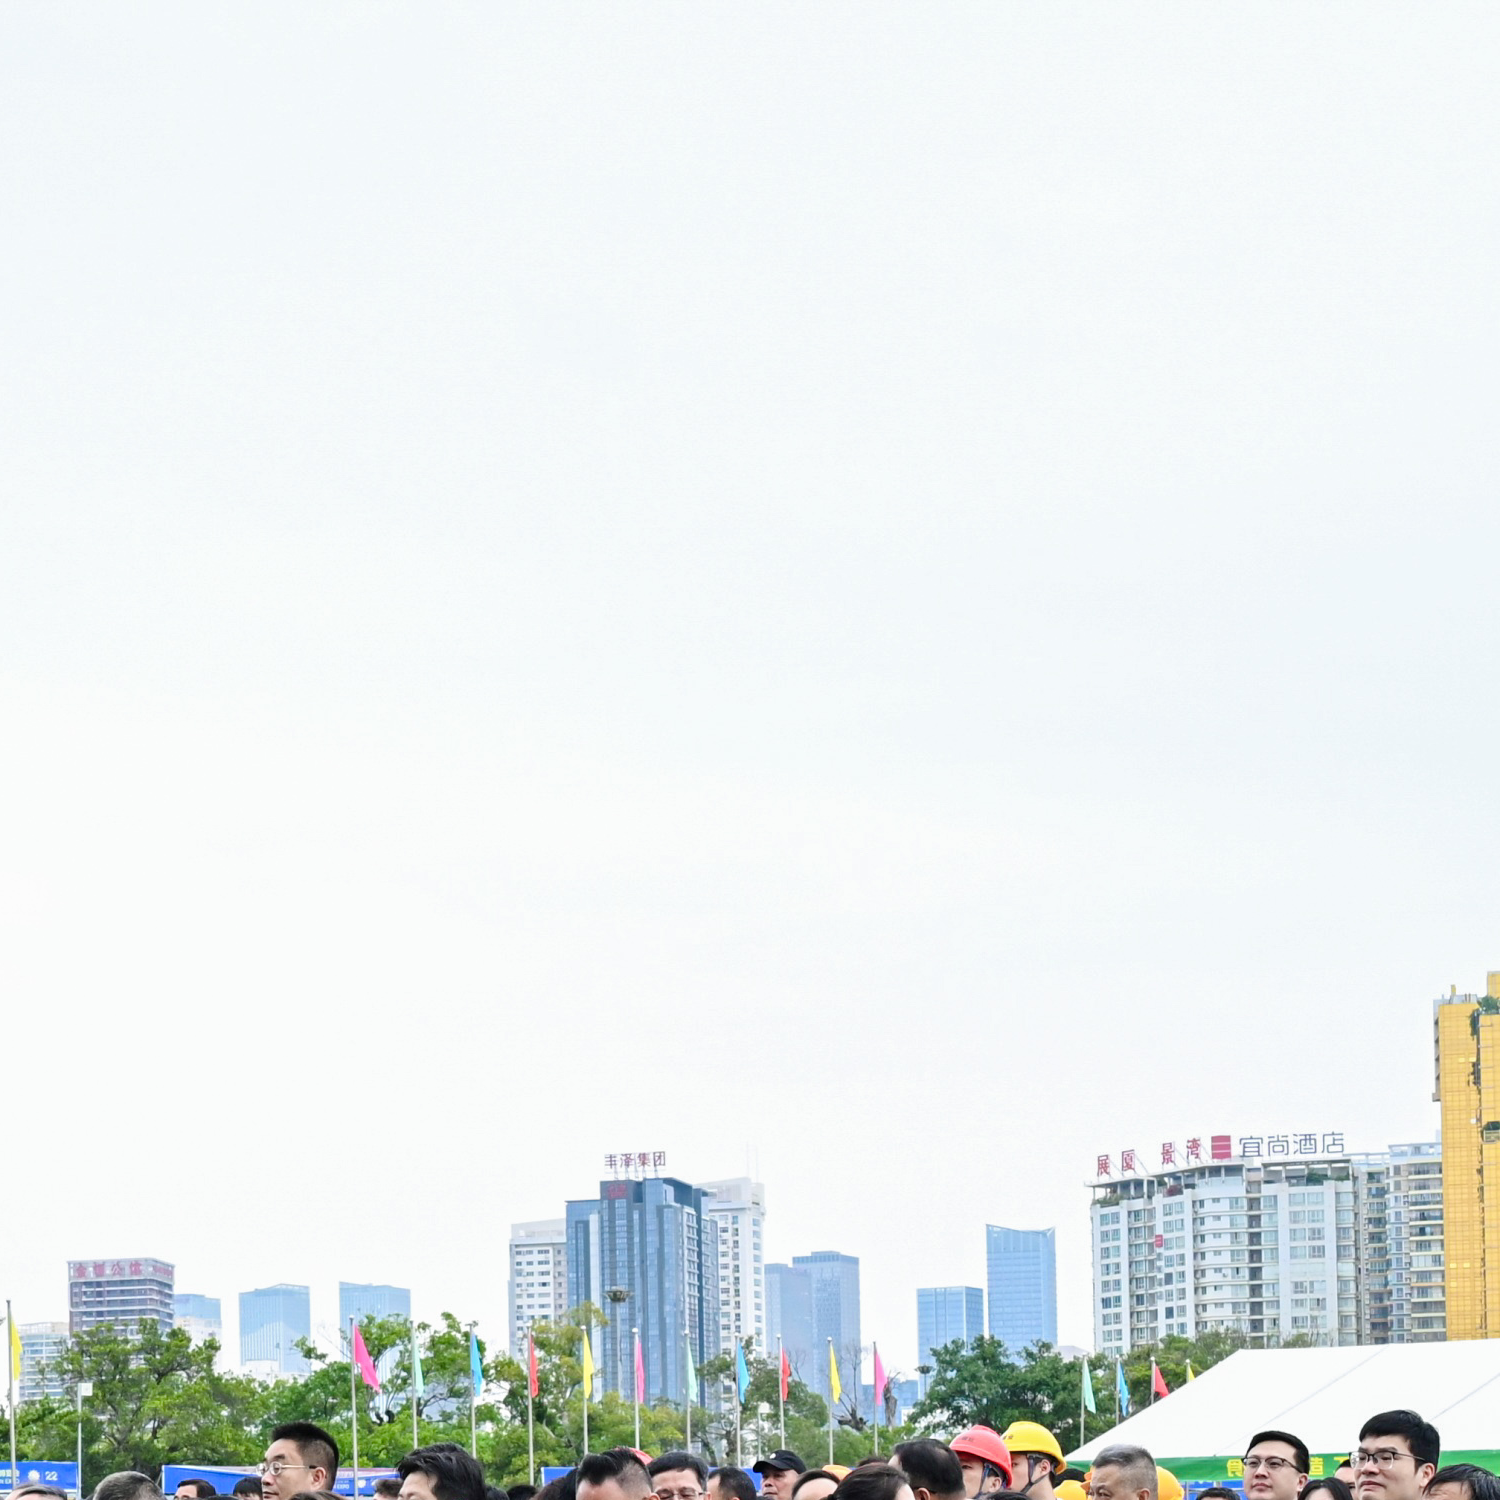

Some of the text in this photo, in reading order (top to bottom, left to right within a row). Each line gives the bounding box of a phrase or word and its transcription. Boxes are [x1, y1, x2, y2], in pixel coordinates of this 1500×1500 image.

[1239, 1132, 1345, 1157] 宜尚酒店
[604, 1151, 666, 1169] 丰泽集团
[45, 1472, 58, 1481] 22
